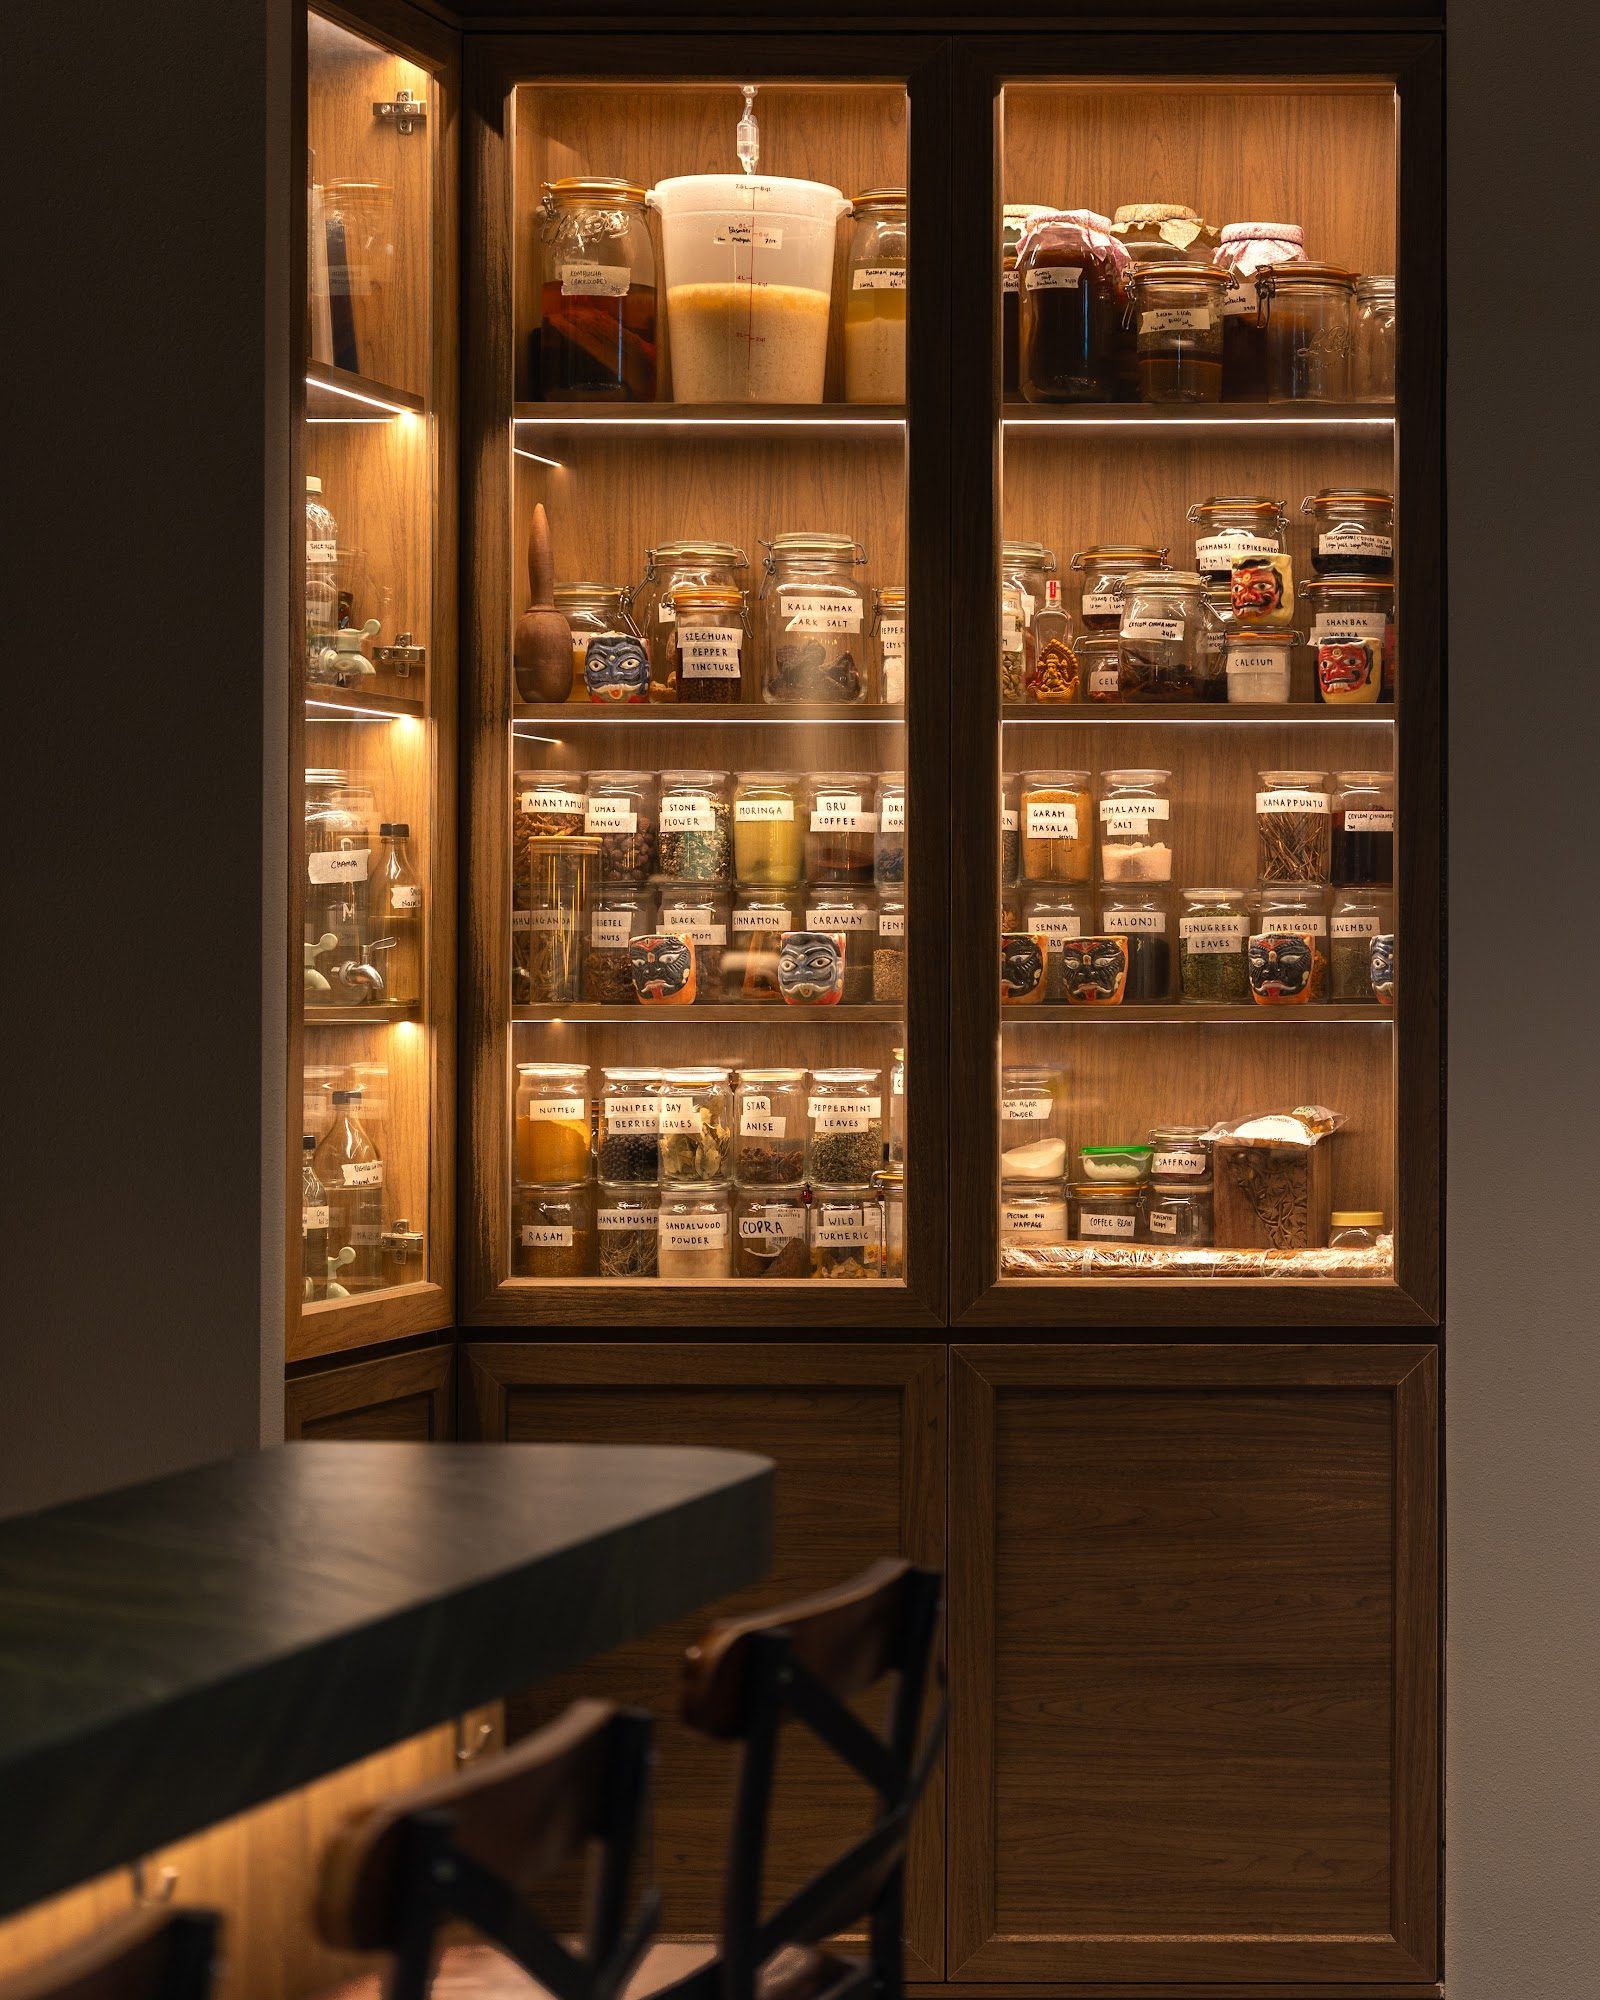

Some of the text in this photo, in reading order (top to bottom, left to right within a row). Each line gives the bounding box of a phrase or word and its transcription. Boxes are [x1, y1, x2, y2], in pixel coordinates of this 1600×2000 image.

[787, 603, 853, 612] KALA NAMAK
[794, 618, 848, 628] ARK SALT
[692, 648, 728, 656] PEPPER
[691, 664, 735, 672] TINCTURE
[826, 802, 846, 811] BRU
[1102, 806, 1155, 814] HIMALAYAN
[739, 807, 783, 815] MORINGA
[664, 818, 700, 826] FLOWER
[819, 818, 856, 826] COFFEE
[1113, 821, 1132, 829] SALT
[734, 917, 779, 925] CINNAMON
[814, 916, 862, 924] CARAWAY
[1184, 924, 1239, 933] FENUGREEK
[1269, 923, 1318, 931] MARIGOLD
[1195, 940, 1230, 948] LEAVES
[611, 1104, 654, 1112] JUNIPER
[746, 1101, 767, 1110] STAR
[814, 1104, 871, 1112] PEPPERMINT
[615, 1120, 656, 1128] BERRIES
[746, 1122, 774, 1131] ANISE
[1158, 1158, 1197, 1167] SAFFRON
[666, 1222, 721, 1230] SANDALWOOD
[829, 1218, 855, 1226] WILD
[742, 1221, 784, 1234] COPRA
[528, 1231, 563, 1240] RASAM
[819, 1232, 869, 1240] TURMERIC
